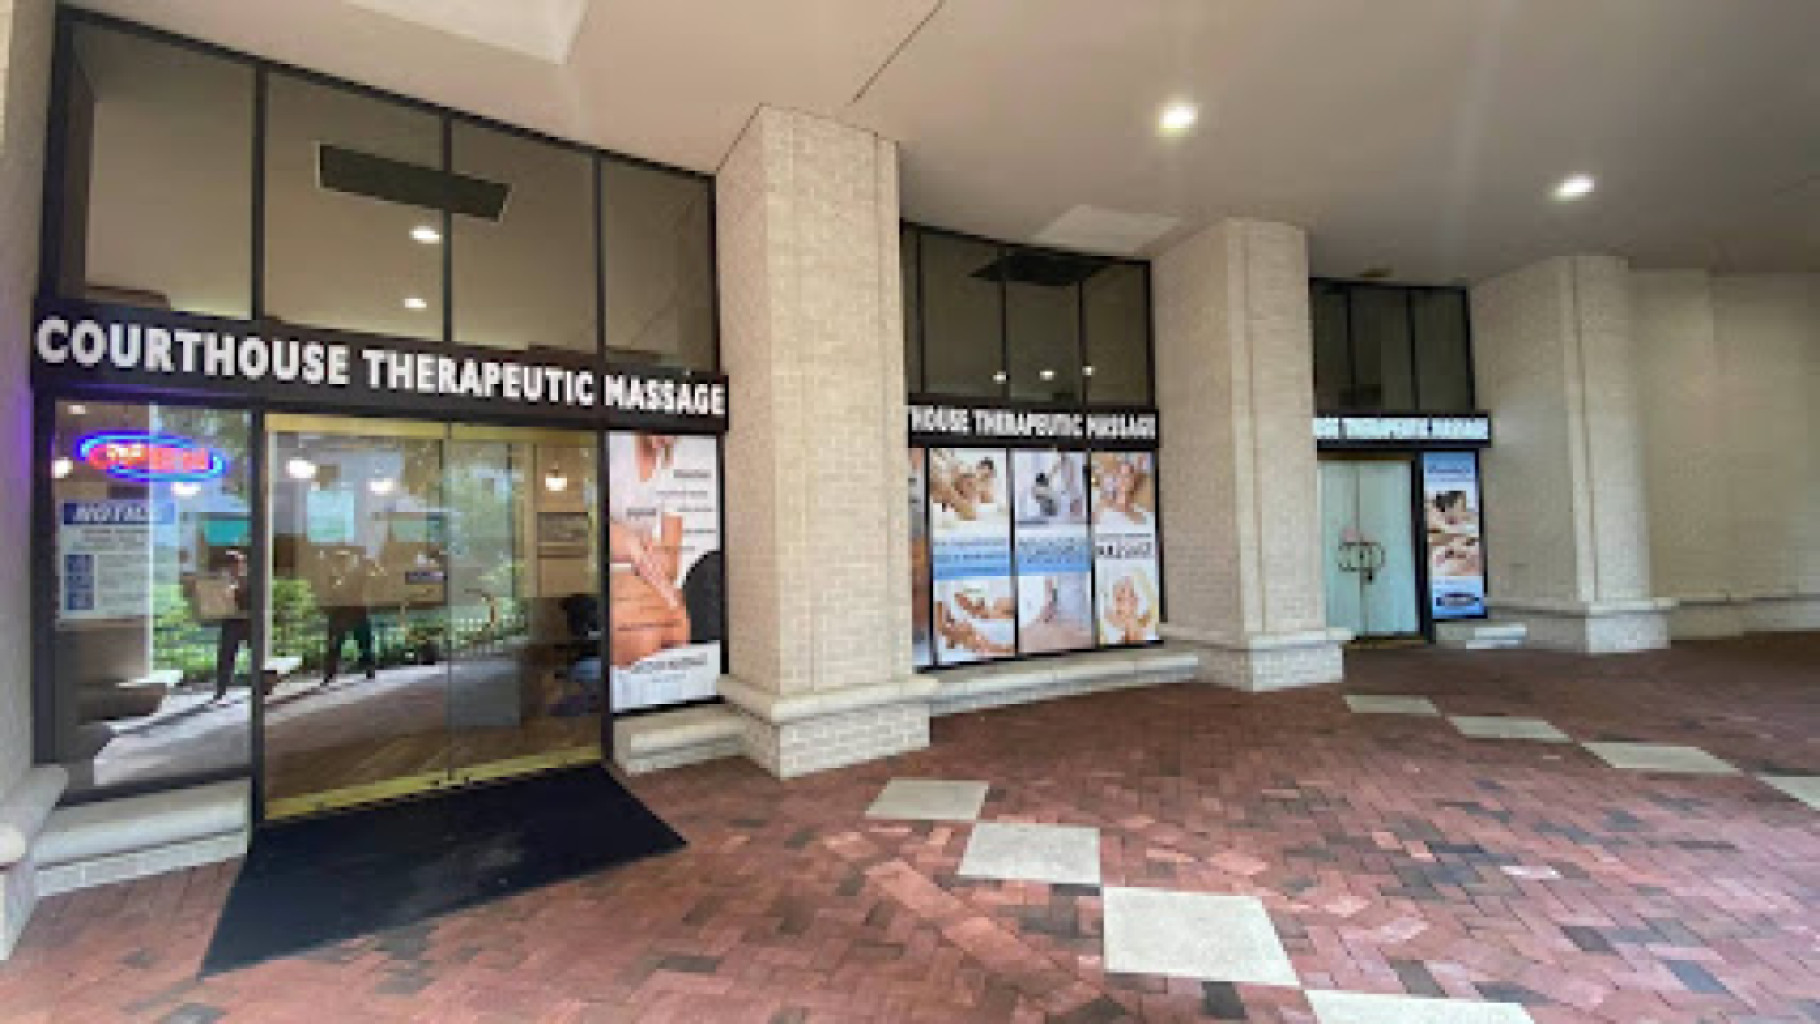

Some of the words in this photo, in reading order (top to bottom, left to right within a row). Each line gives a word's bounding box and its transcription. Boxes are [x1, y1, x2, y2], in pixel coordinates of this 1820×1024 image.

[36, 316, 350, 385] COURTHOUSE
[362, 349, 596, 406] THERAPEUTIC
[604, 374, 727, 416] MASSAGE
[971, 409, 1084, 437] THERAPEUTIC
[1086, 413, 1157, 440] MASSAGE
